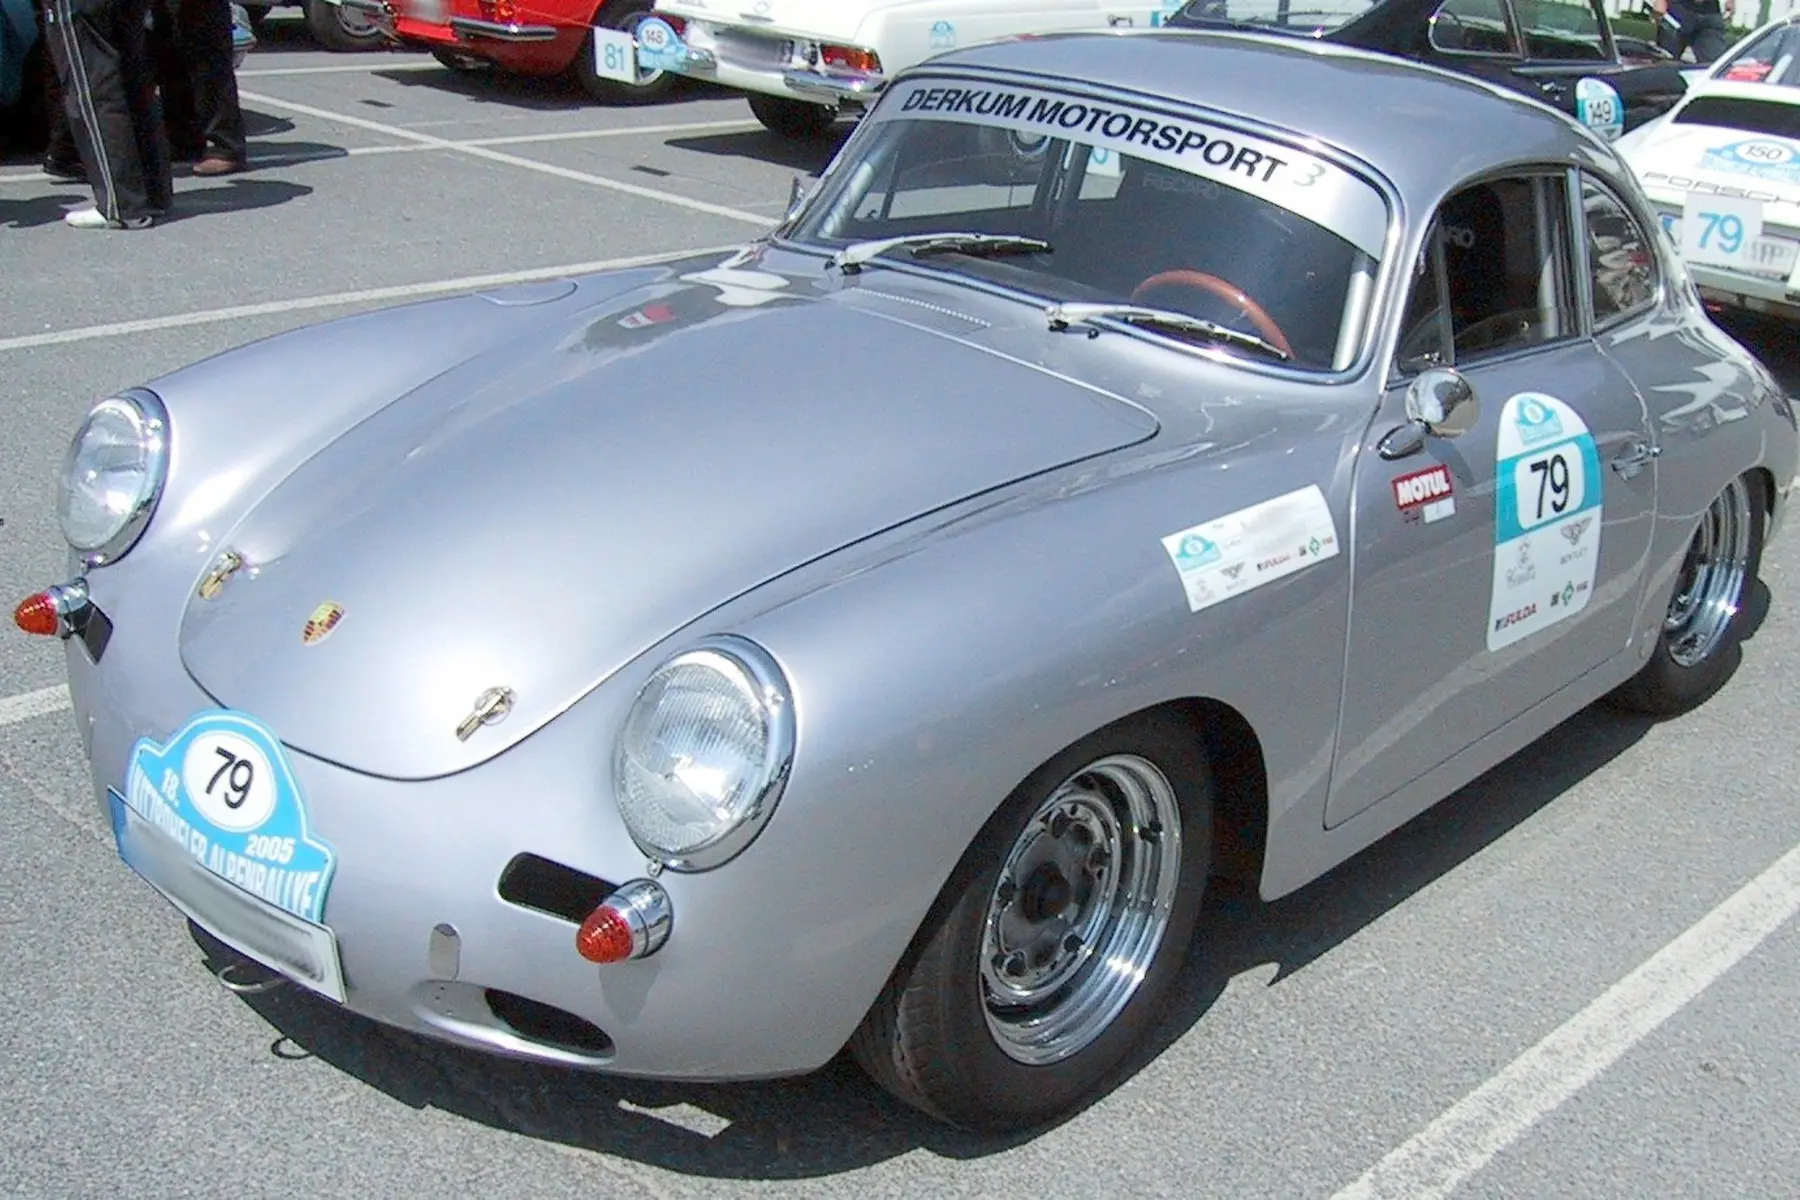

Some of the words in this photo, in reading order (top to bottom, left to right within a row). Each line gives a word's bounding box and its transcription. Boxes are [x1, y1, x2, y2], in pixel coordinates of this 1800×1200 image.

[604, 43, 625, 71] 81
[1588, 100, 1612, 123] 149
[901, 88, 1031, 119] DERKUM
[1033, 97, 1288, 183] MOTORSPORT
[1745, 144, 1783, 161] 150
[1293, 161, 1327, 188] 3
[1697, 211, 1744, 254] 79
[1396, 469, 1450, 506] MOTUL
[1530, 454, 1570, 520] 79
[205, 745, 255, 810] 79
[245, 833, 296, 864] 2005
